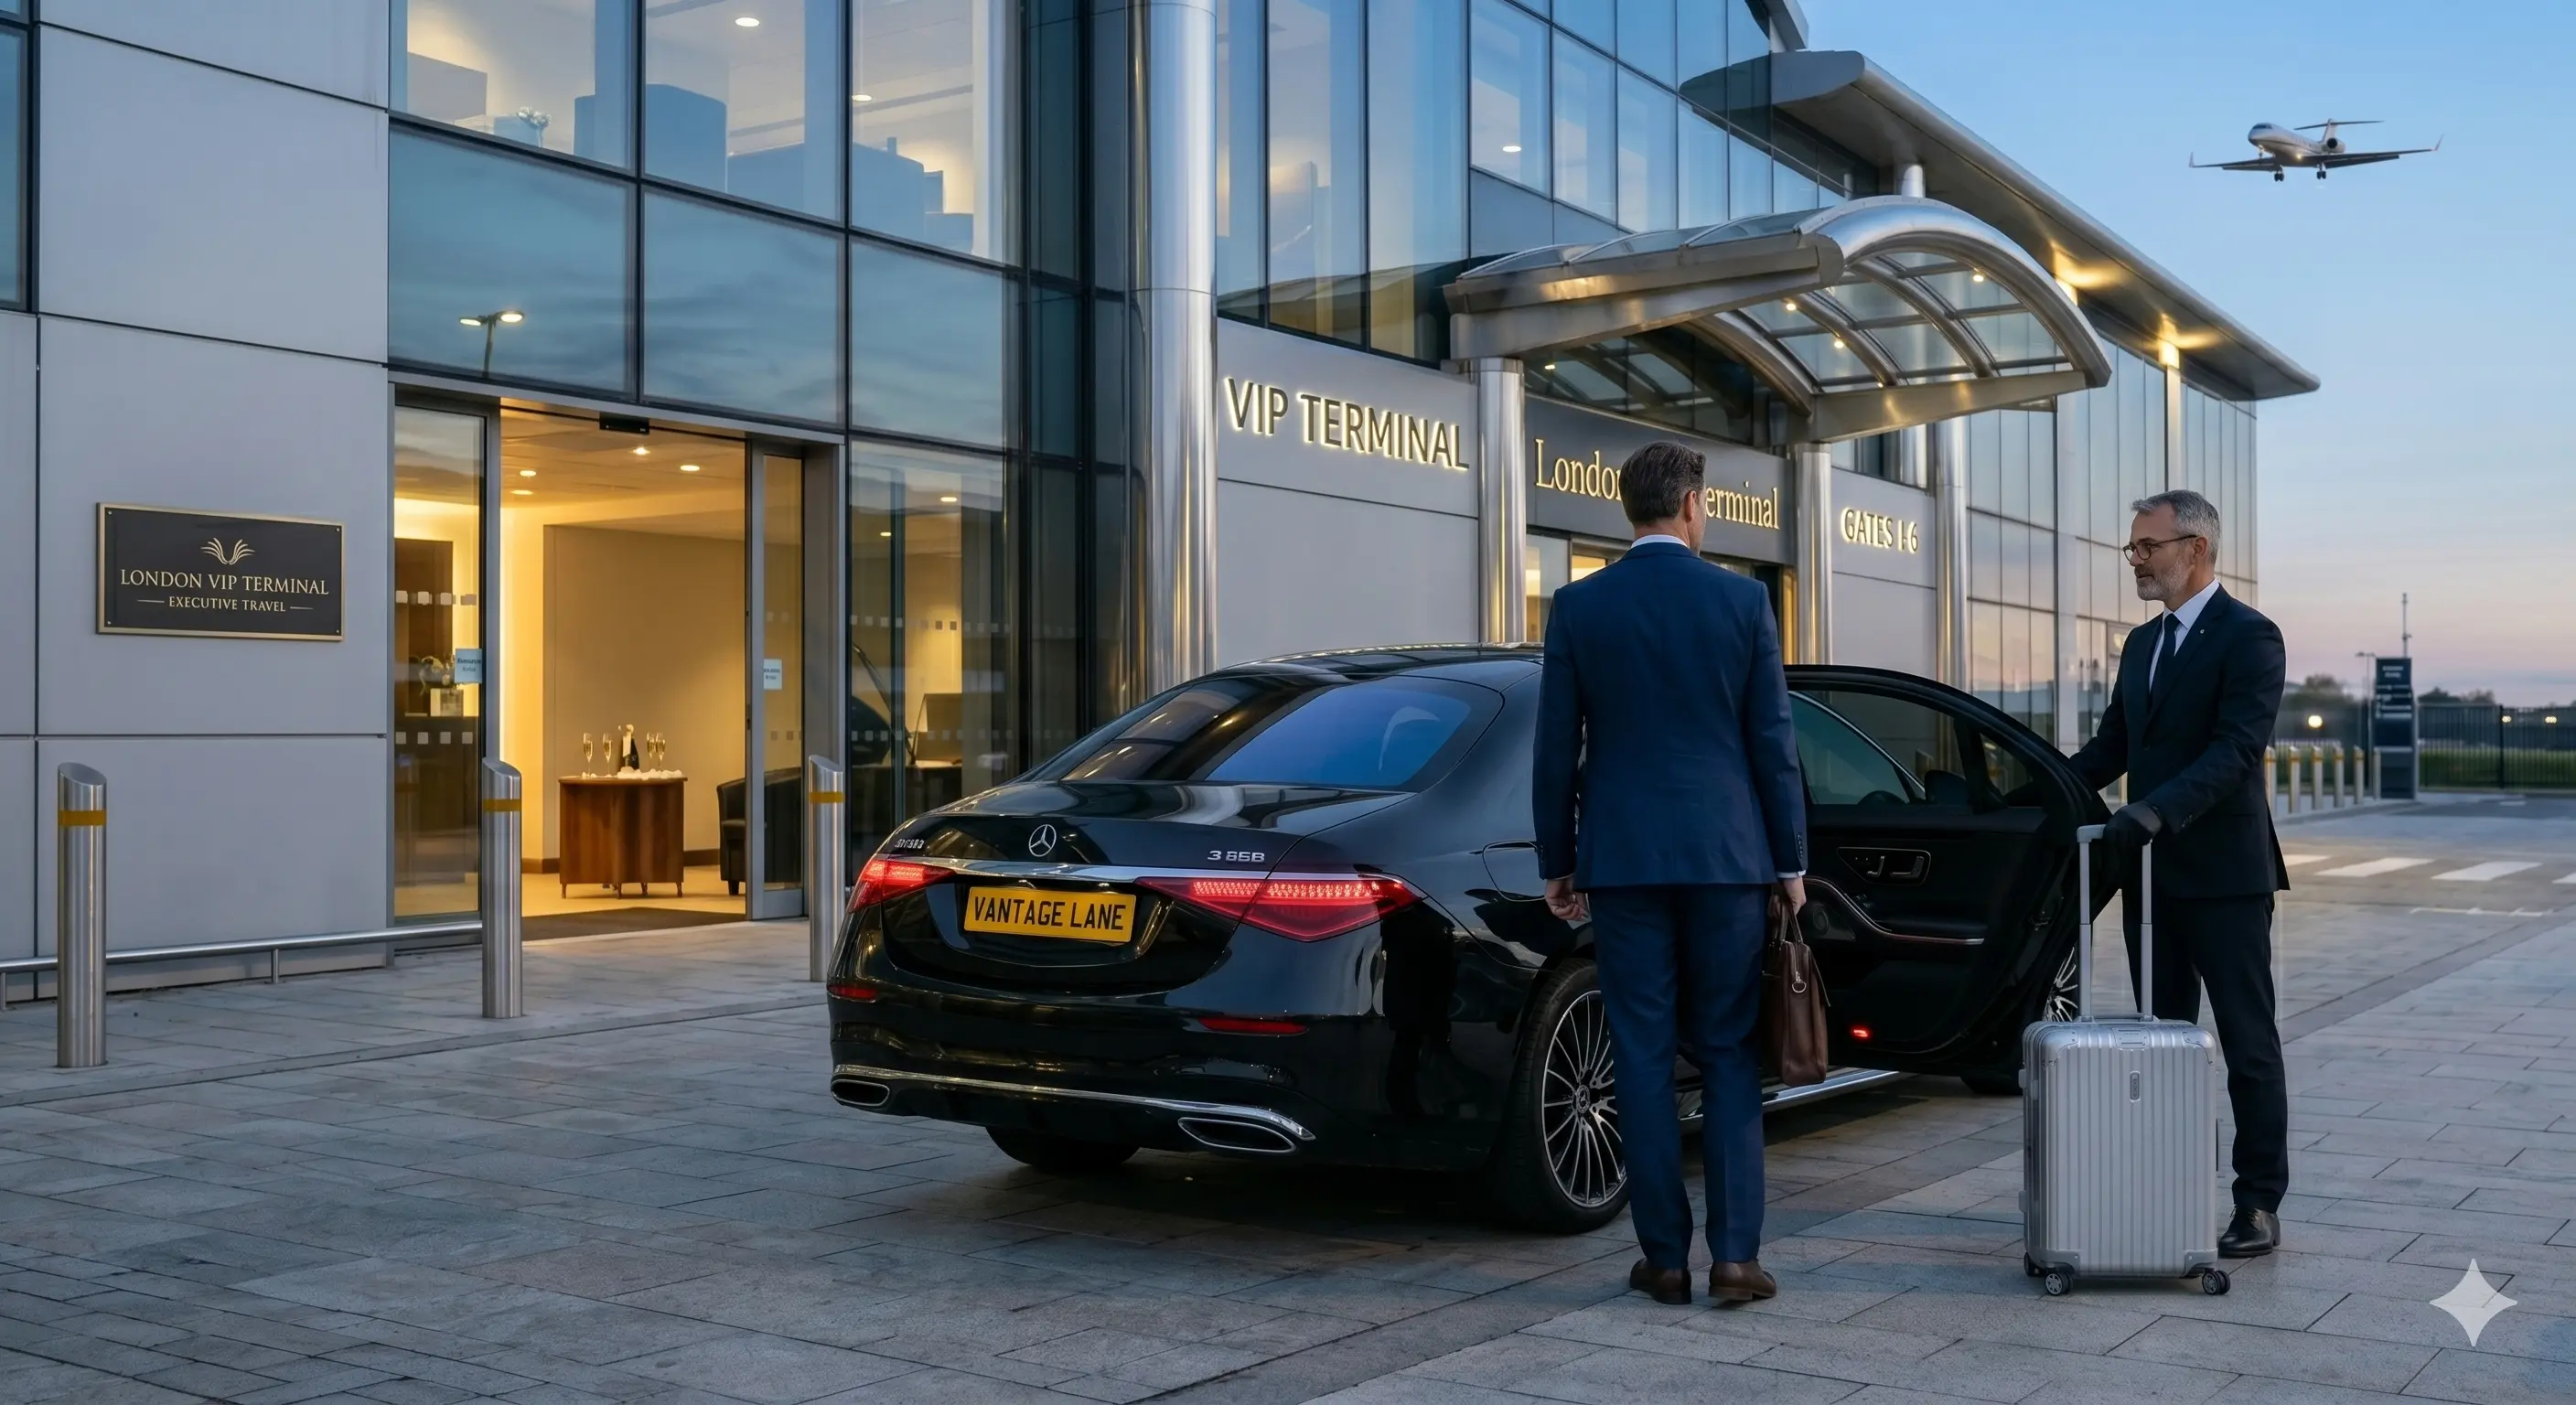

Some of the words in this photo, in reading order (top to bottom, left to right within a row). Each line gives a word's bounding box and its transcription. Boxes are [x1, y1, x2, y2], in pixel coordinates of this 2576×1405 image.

[1224, 377, 1289, 436] VIP
[1295, 391, 1470, 471] TERMINAL
[1705, 480, 1780, 531] erminal
[1841, 507, 1894, 549] GATES
[120, 568, 202, 589] LONDON
[207, 574, 238, 590] VIP
[242, 575, 329, 595] TERMINAL
[168, 595, 238, 610] EXECUTIVE
[242, 599, 286, 612] TRAVEL
[974, 896, 1066, 927] VANTAGE
[1069, 902, 1127, 930] LANE
